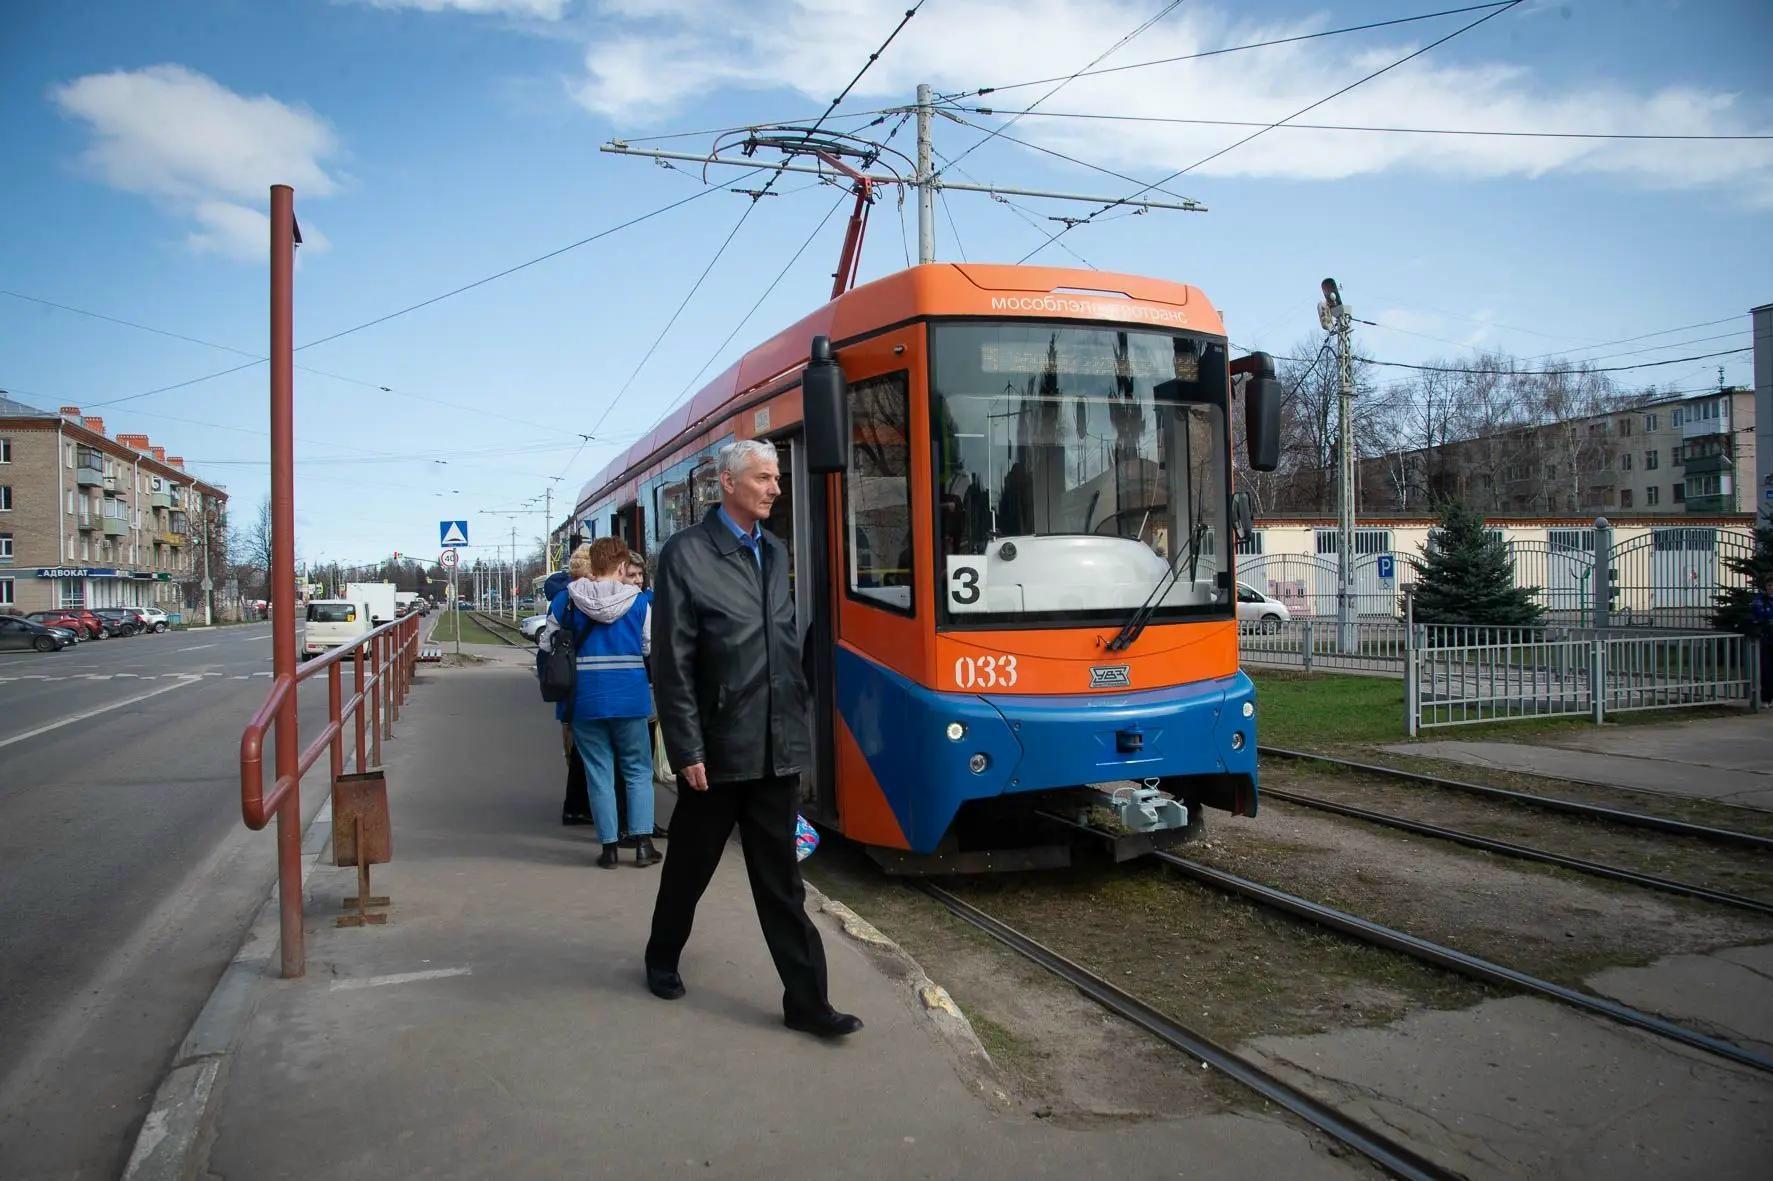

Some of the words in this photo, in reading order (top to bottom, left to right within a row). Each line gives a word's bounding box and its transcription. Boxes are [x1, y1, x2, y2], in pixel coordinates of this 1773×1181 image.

[991, 295, 1188, 324] мособлэлротранс
[43, 569, 88, 577] АДВОКАТ
[1381, 558, 1391, 576] P
[951, 566, 980, 605] 3
[955, 654, 1018, 688] 033
